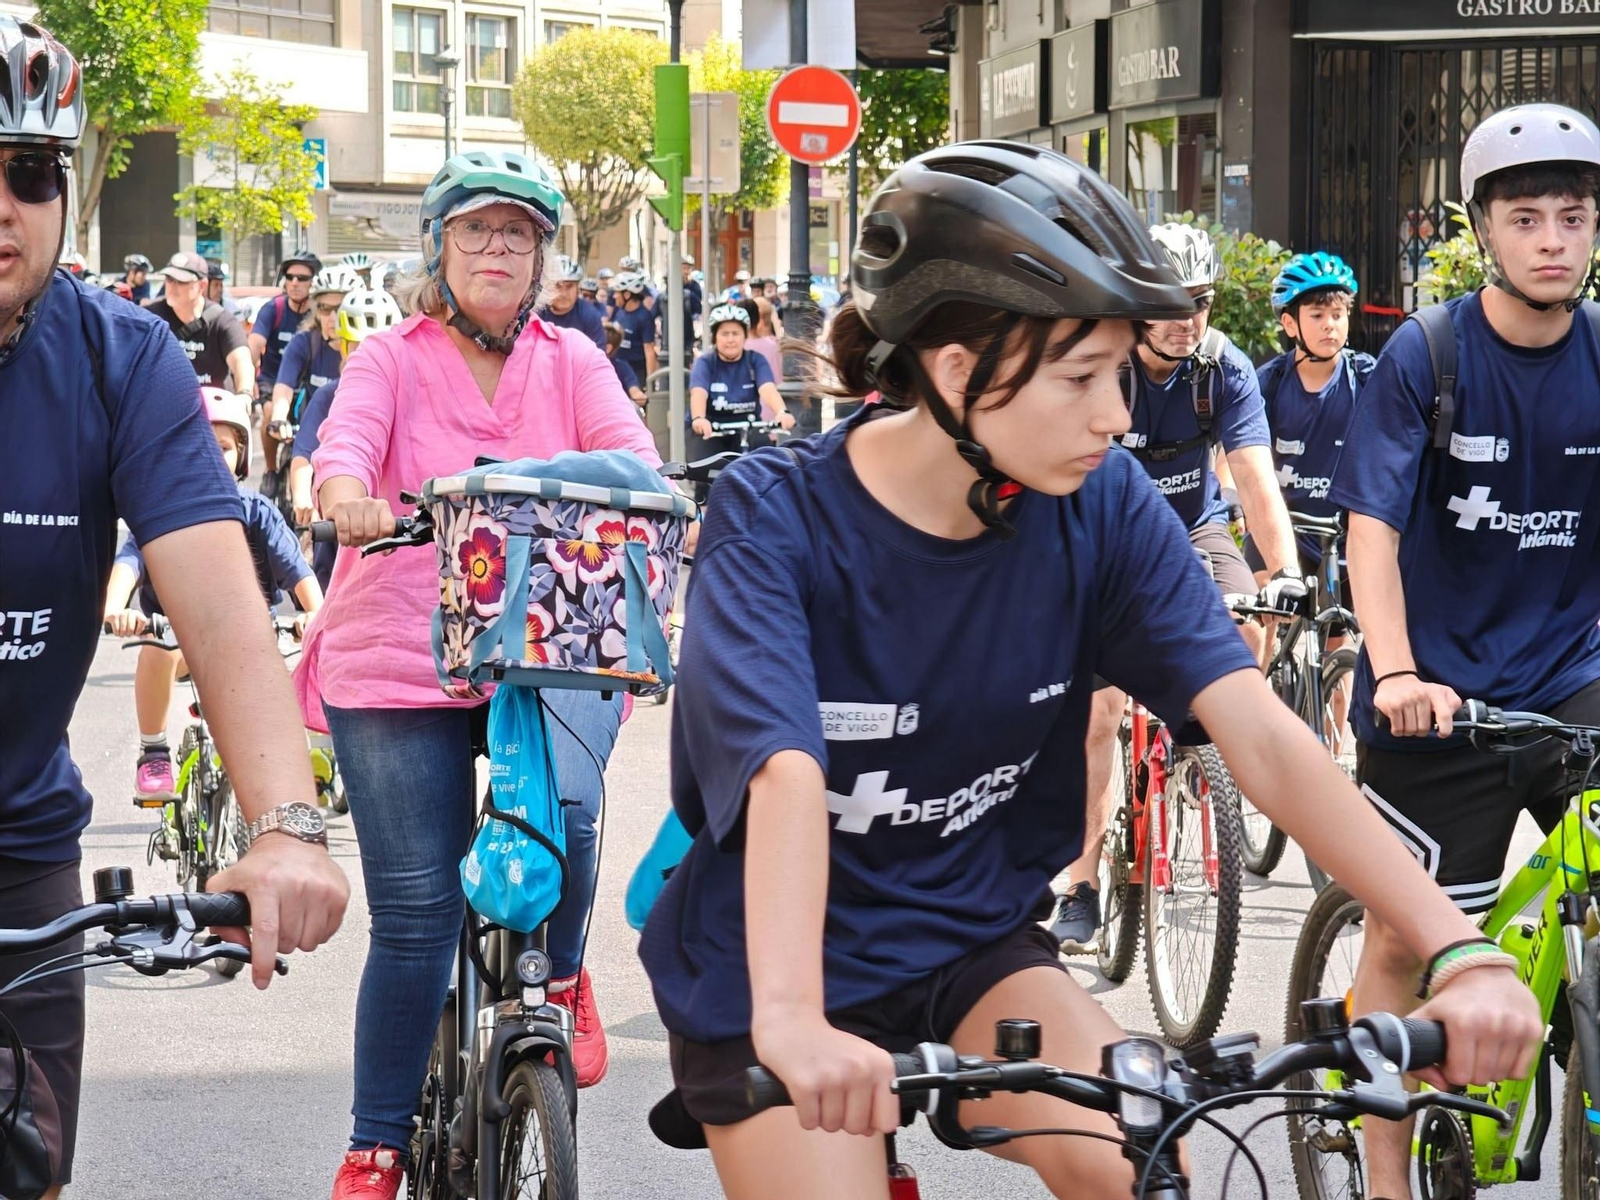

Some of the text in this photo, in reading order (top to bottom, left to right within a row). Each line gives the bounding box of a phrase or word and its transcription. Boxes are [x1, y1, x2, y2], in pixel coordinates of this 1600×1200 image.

[1457, 0, 1553, 17] GASTRO
[1150, 46, 1181, 80] BAR
[1453, 438, 1491, 449] CONCELLO
[1456, 447, 1486, 456] DE VIGO
[3, 511, 79, 526] DÍA DE LA BICI
[819, 711, 888, 721] CONCELLO
[825, 723, 879, 732] DE VIGO
[499, 780, 516, 793] vive
